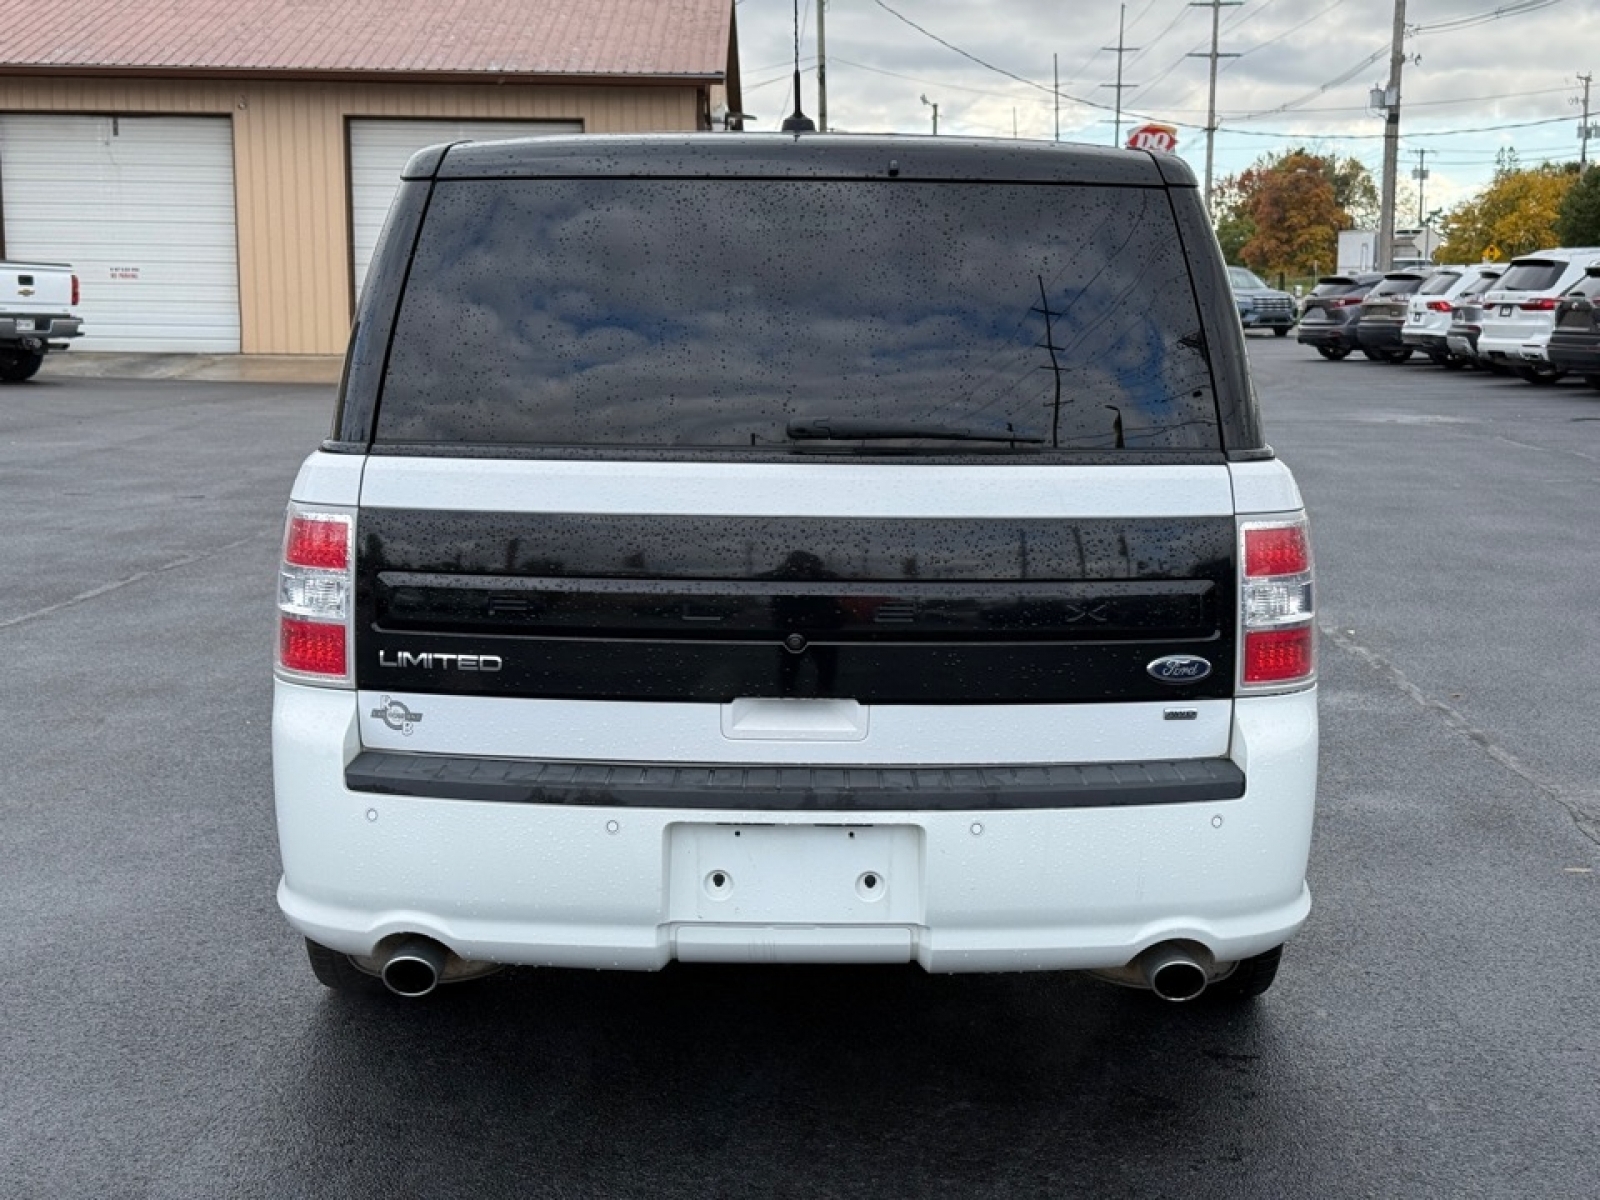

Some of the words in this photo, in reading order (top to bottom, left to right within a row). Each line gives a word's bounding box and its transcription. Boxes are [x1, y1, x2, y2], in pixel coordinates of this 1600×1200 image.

[1136, 132, 1170, 153] DQ
[379, 650, 502, 671] LIMITED
[1162, 660, 1199, 676] Ford
